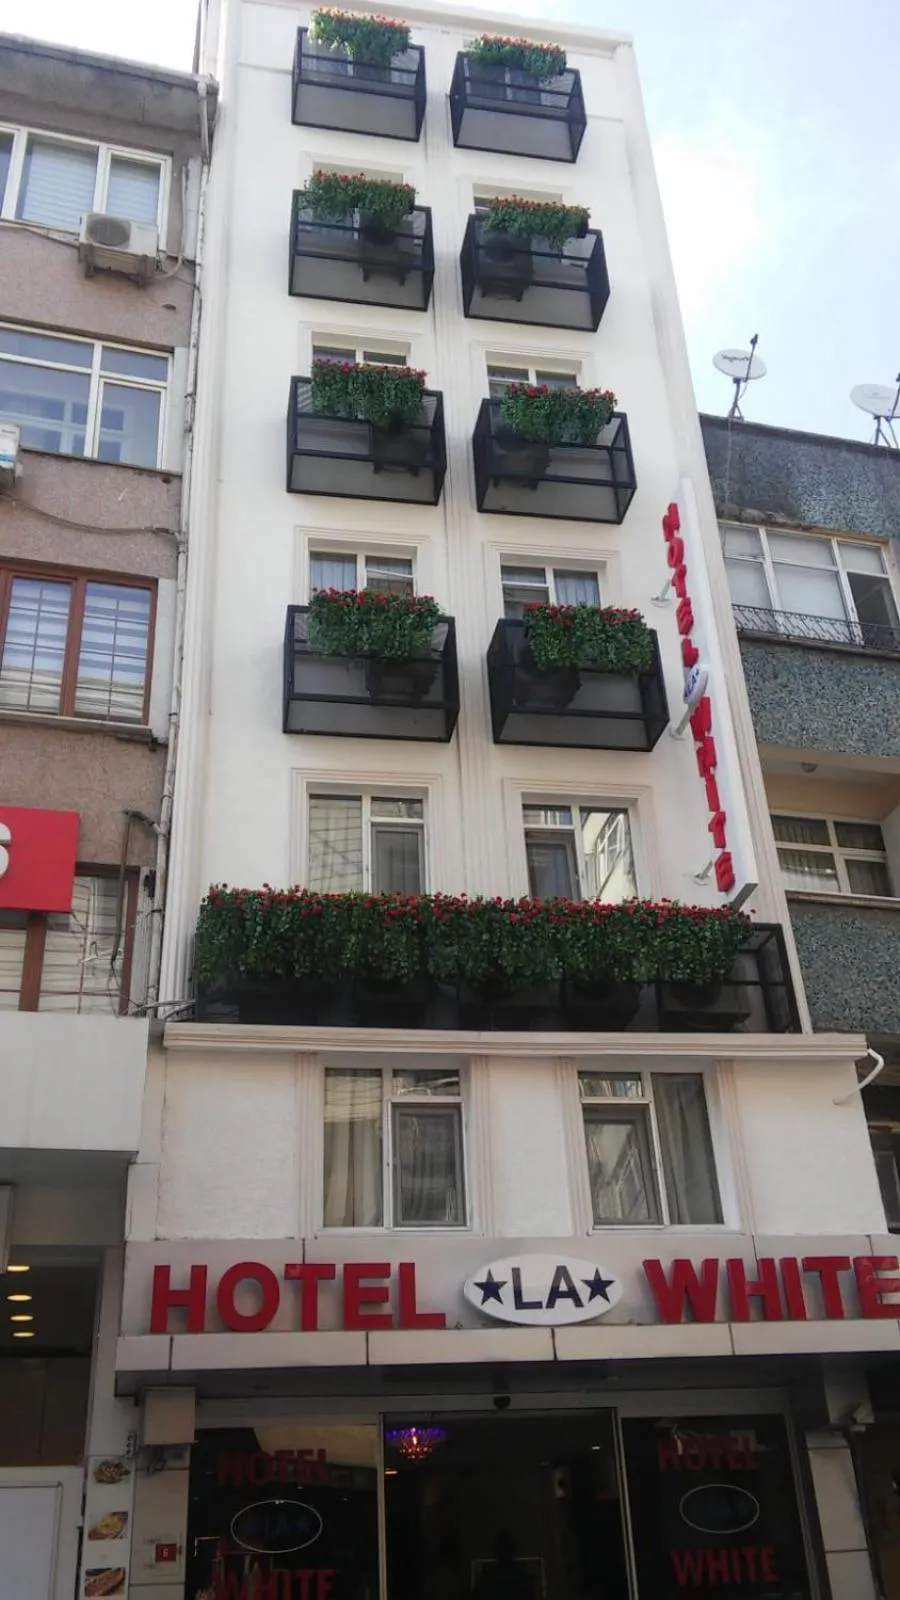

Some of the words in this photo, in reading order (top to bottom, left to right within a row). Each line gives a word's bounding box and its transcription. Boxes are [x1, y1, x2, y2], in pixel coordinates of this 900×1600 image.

[662, 502, 700, 668] HOTEL
[150, 1261, 446, 1333] HOTEL
[511, 1265, 584, 1310] LA
[642, 1256, 900, 1323] WHITE
[217, 1448, 330, 1487] HOTEL
[658, 1434, 760, 1472] HOTEL
[212, 1567, 338, 1600] WHITE
[671, 1545, 780, 1586] WHITE
